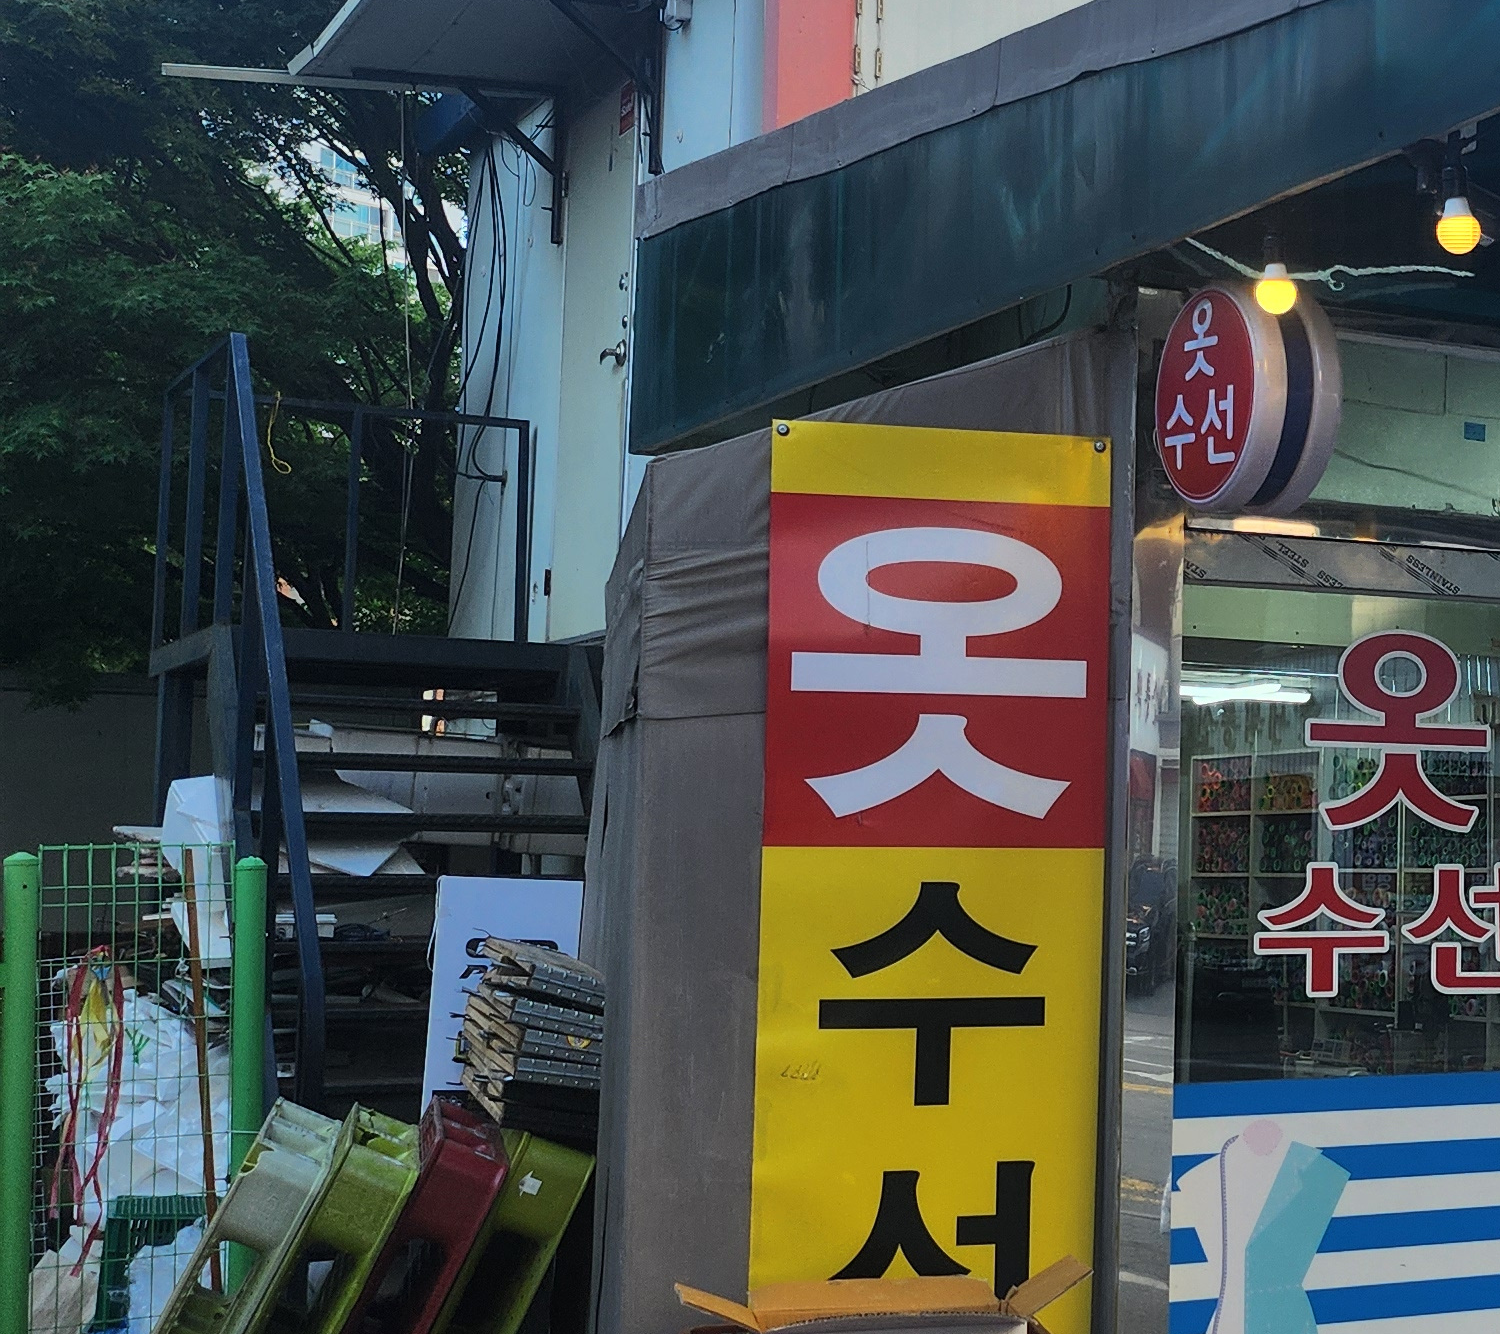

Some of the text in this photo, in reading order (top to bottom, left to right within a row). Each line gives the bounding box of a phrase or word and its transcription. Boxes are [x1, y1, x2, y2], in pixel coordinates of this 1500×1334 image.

[1183, 299, 1218, 378] 옷
[1164, 387, 1236, 471] 수선
[1305, 629, 1492, 833] 옷
